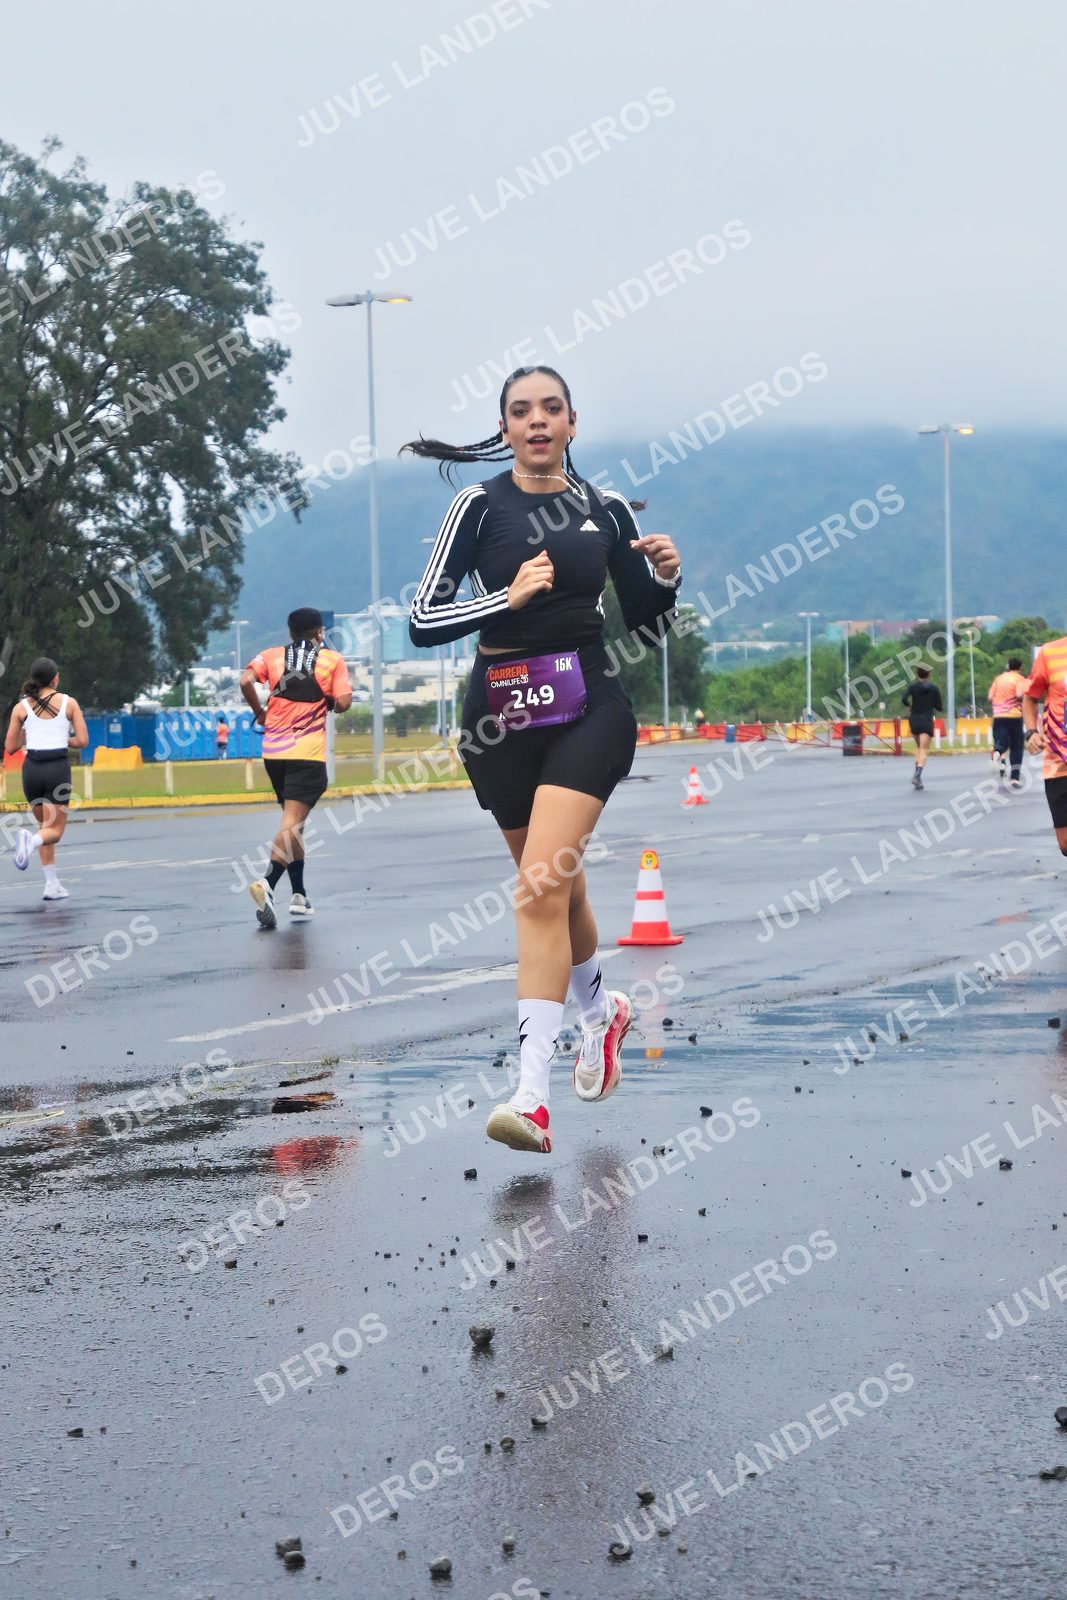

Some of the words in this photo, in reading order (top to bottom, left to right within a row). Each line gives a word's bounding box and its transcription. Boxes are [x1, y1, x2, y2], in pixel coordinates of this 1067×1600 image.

[490, 664, 529, 681] CARRERA
[490, 678, 520, 689] OMNILIFE
[511, 685, 555, 709] 249
